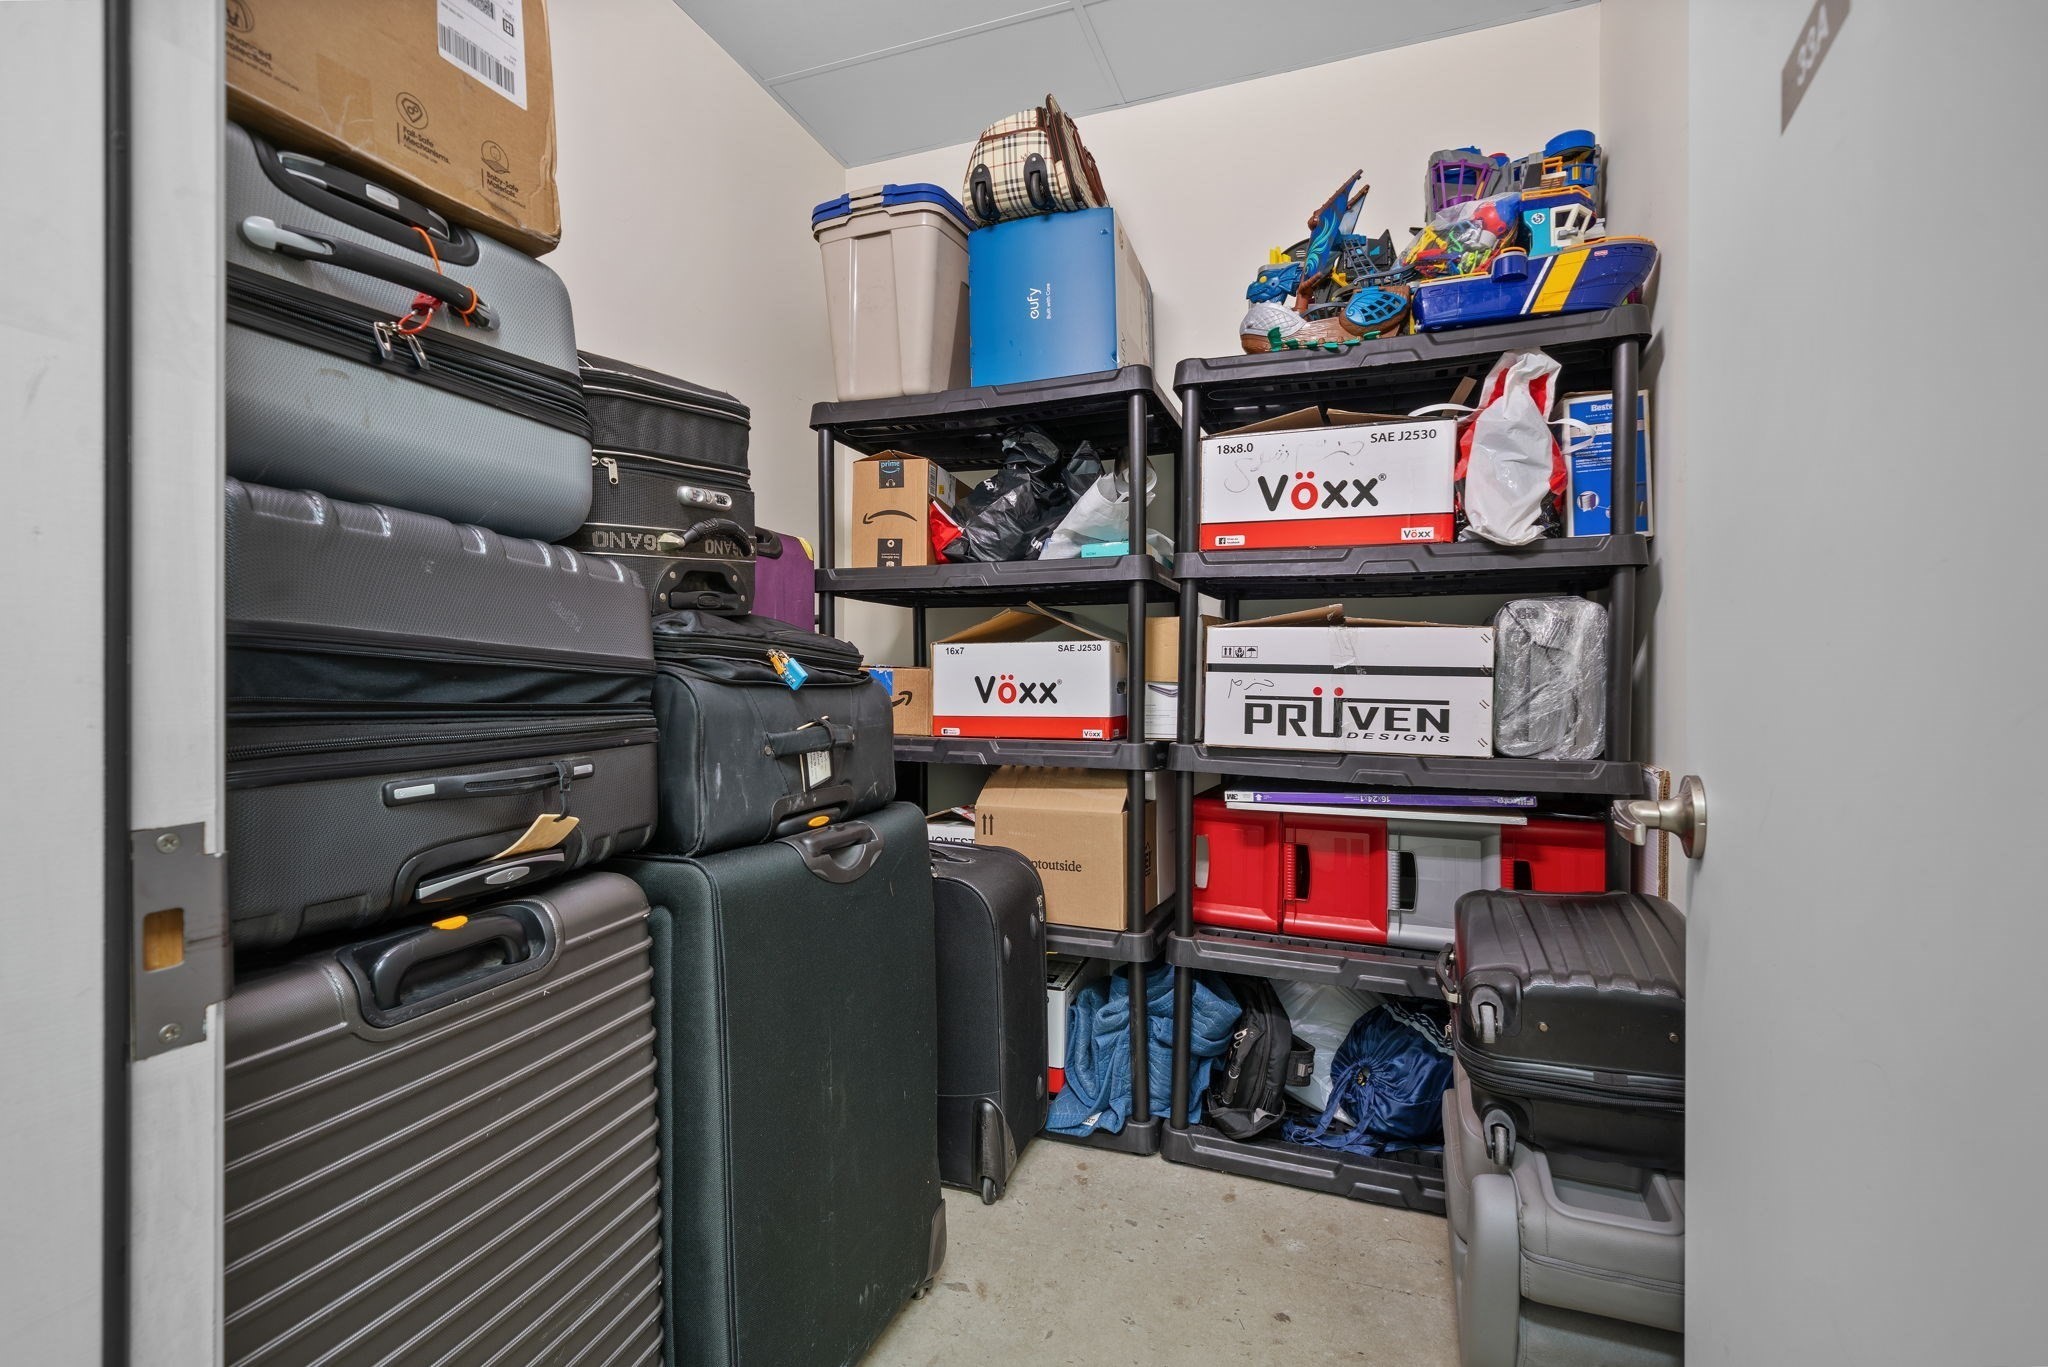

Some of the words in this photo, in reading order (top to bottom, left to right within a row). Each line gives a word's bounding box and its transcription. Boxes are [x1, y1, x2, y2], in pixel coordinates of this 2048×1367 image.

[1027, 287, 1041, 320] eufy
[1370, 432, 1395, 443] SAE
[1398, 428, 1437, 442] J2530
[1217, 443, 1254, 455] 18x8.0
[880, 460, 900, 469] prime
[592, 531, 661, 551] GANO
[945, 647, 965, 655] 16x7
[1057, 644, 1075, 652] SAE
[1077, 644, 1102, 652] J2530
[1245, 686, 1450, 738] PRÜVEN
[1346, 731, 1450, 743] DESIGNS
[1031, 859, 1082, 873] ptoutside
